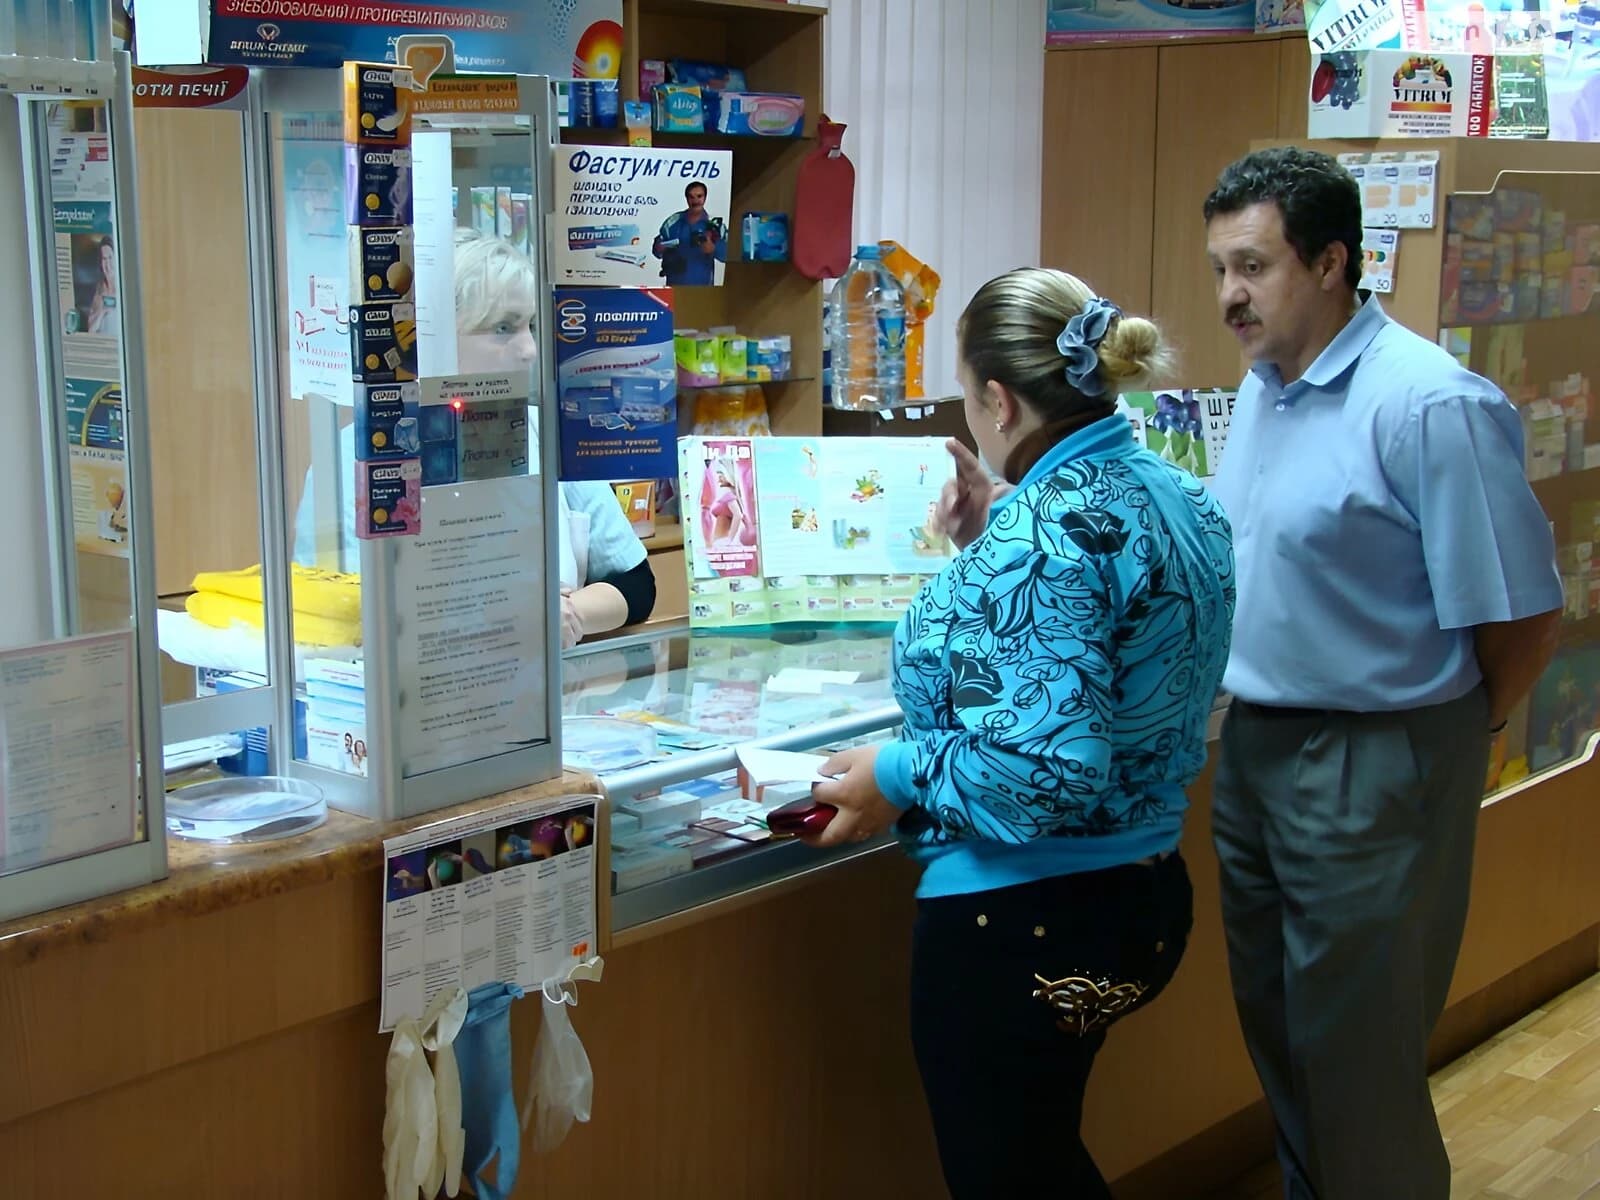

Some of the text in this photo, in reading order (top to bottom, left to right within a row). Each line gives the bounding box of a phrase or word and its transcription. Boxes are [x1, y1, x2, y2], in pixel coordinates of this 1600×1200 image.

[132, 80, 229, 97] ОТИ ПЕЧІЇ
[1393, 88, 1453, 103] VITRUM
[569, 150, 721, 182] Фастум гель
